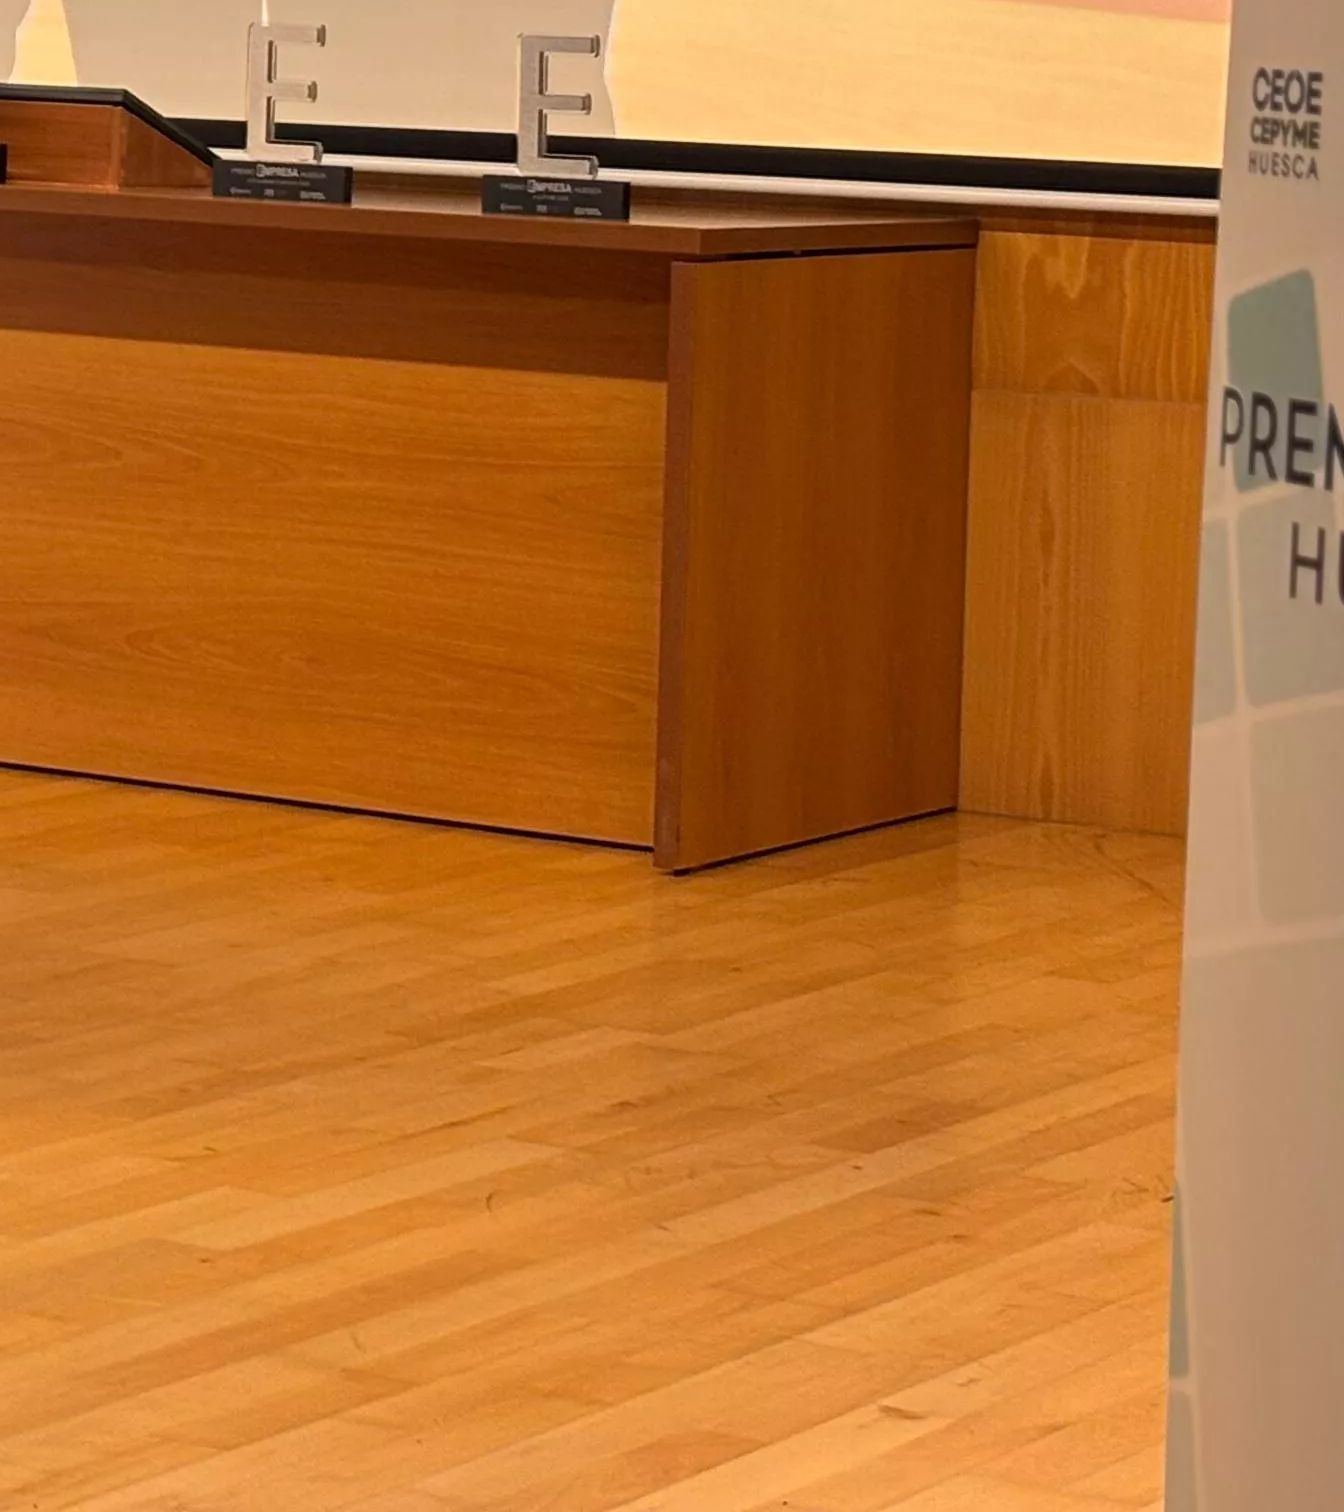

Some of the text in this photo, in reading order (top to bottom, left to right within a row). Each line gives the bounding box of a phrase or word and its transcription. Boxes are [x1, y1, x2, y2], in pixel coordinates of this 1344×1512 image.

[1252, 66, 1324, 116] CEOE
[1250, 115, 1321, 150] CEPYME
[1247, 149, 1320, 181] HUESCA
[1289, 520, 1344, 606] H
